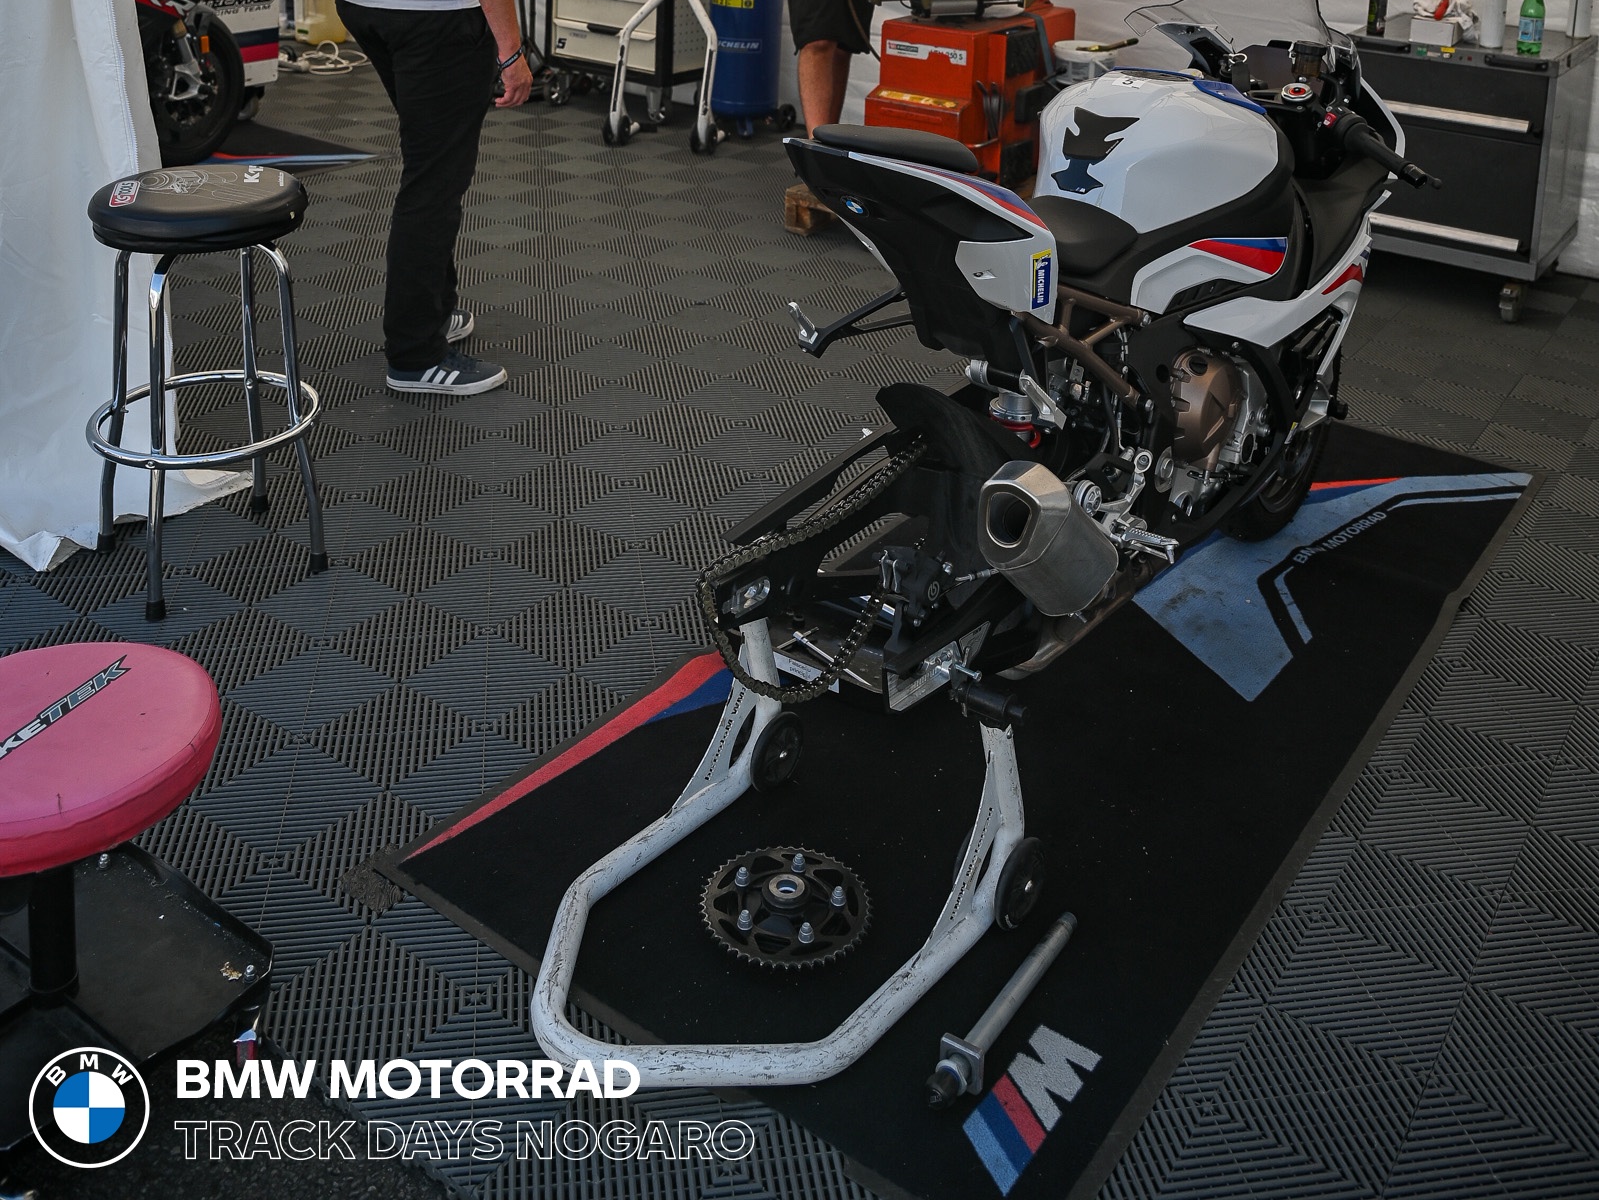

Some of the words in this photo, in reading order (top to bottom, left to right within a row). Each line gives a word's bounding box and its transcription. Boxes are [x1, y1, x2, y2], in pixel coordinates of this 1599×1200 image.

[717, 40, 759, 49] ICHELIN
[1036, 269, 1046, 303] MICHELIN
[1322, 511, 1387, 550] MOTORRAD
